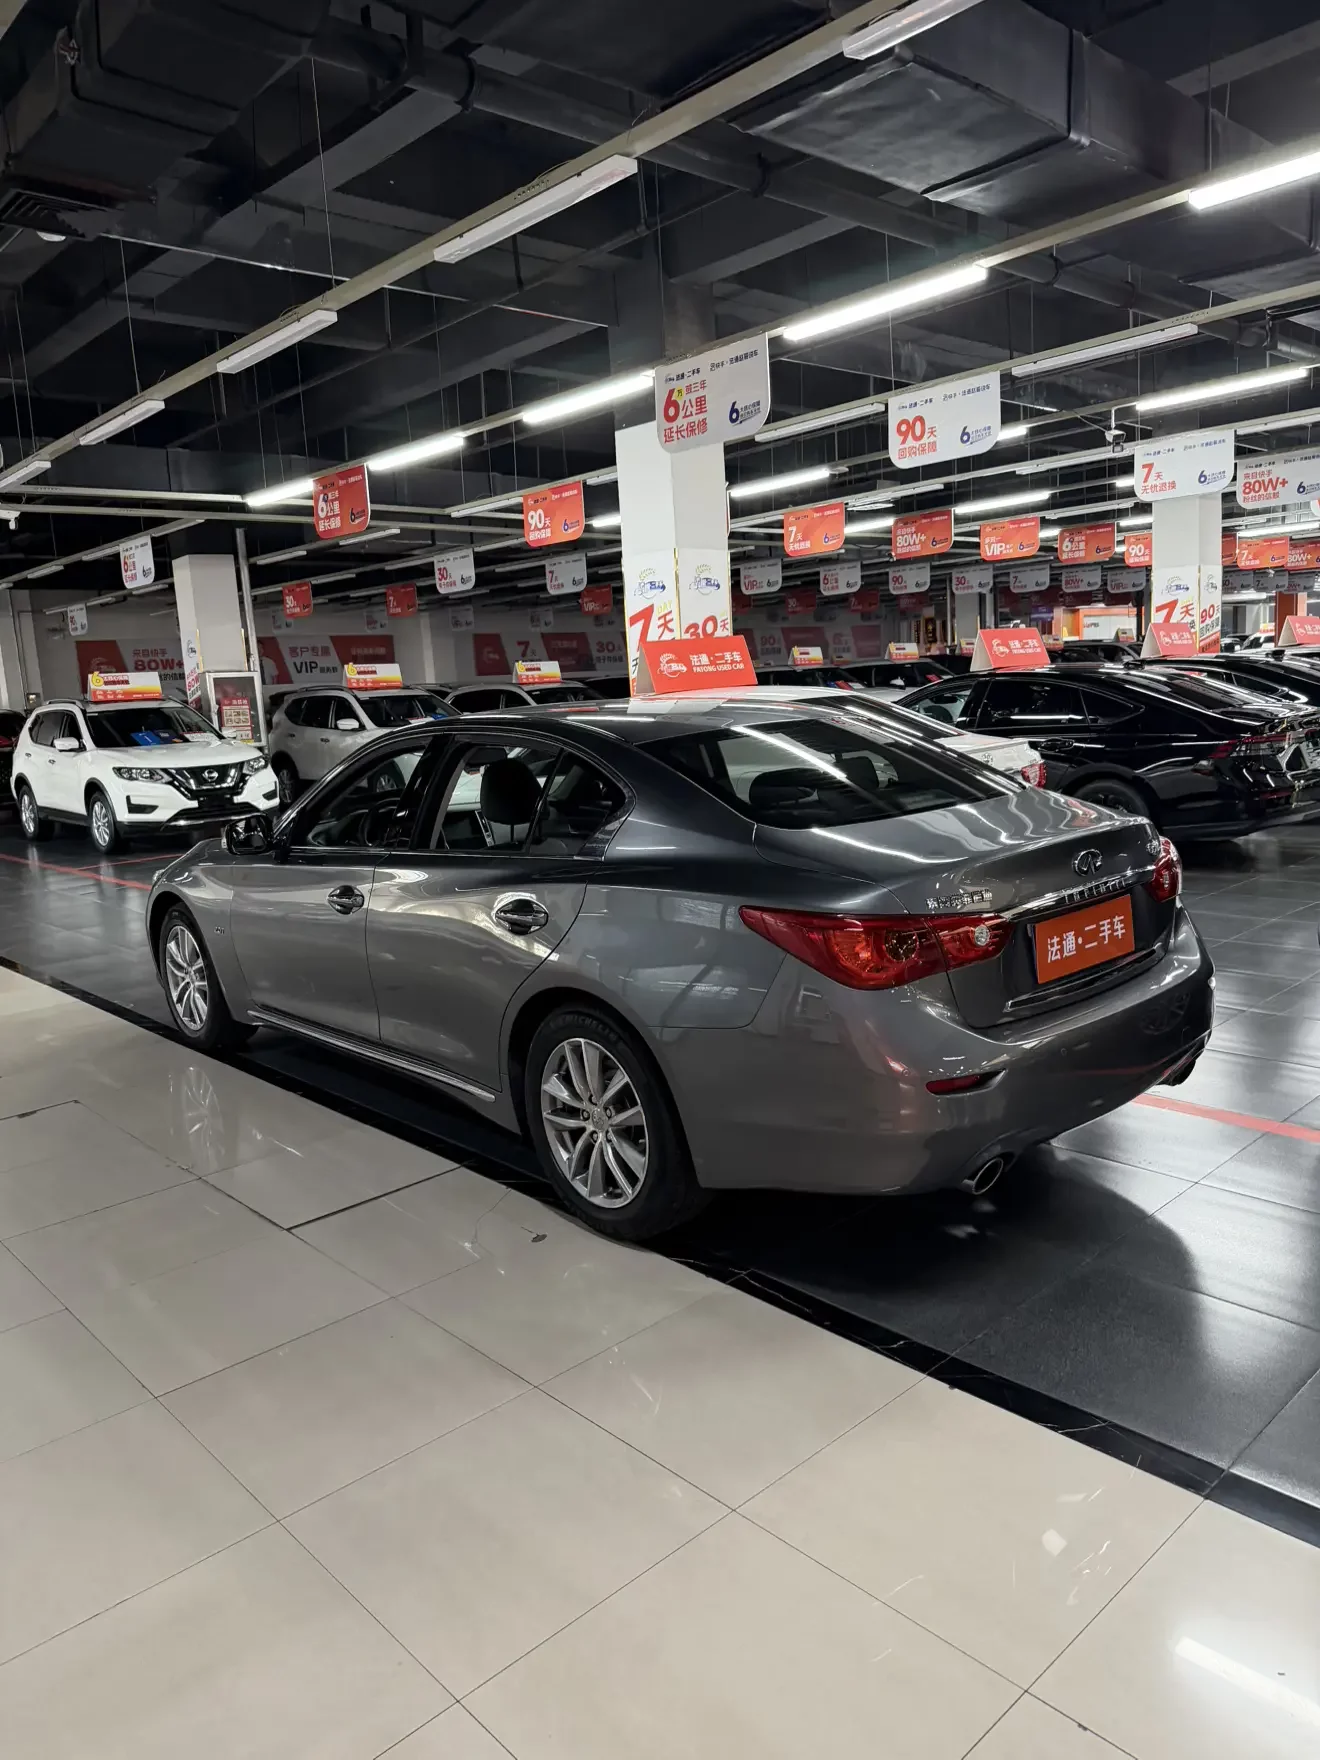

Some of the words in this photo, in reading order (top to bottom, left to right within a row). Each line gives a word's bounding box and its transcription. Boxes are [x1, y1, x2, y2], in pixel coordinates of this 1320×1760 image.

[685, 379, 707, 396] 或三年
[681, 395, 708, 419] 公里
[663, 418, 708, 444] 延长保修
[897, 442, 937, 460] 回购保障
[1243, 469, 1273, 480] 来自快手
[1140, 480, 1176, 495] 无忧退换
[1242, 476, 1289, 496] 80W+
[1242, 491, 1280, 504] 粉丝的信赖
[896, 532, 927, 547] 80W+
[985, 543, 1005, 556] VIP
[743, 579, 758, 591] VIP
[134, 658, 185, 672] 80W+
[689, 651, 743, 666] 法通·二手车
[293, 660, 319, 674] VIP
[692, 665, 717, 673] FATONG
[716, 664, 732, 672] USED
[1064, 877, 1126, 904] INFINITI
[1047, 914, 1126, 964] 法通·二手车
